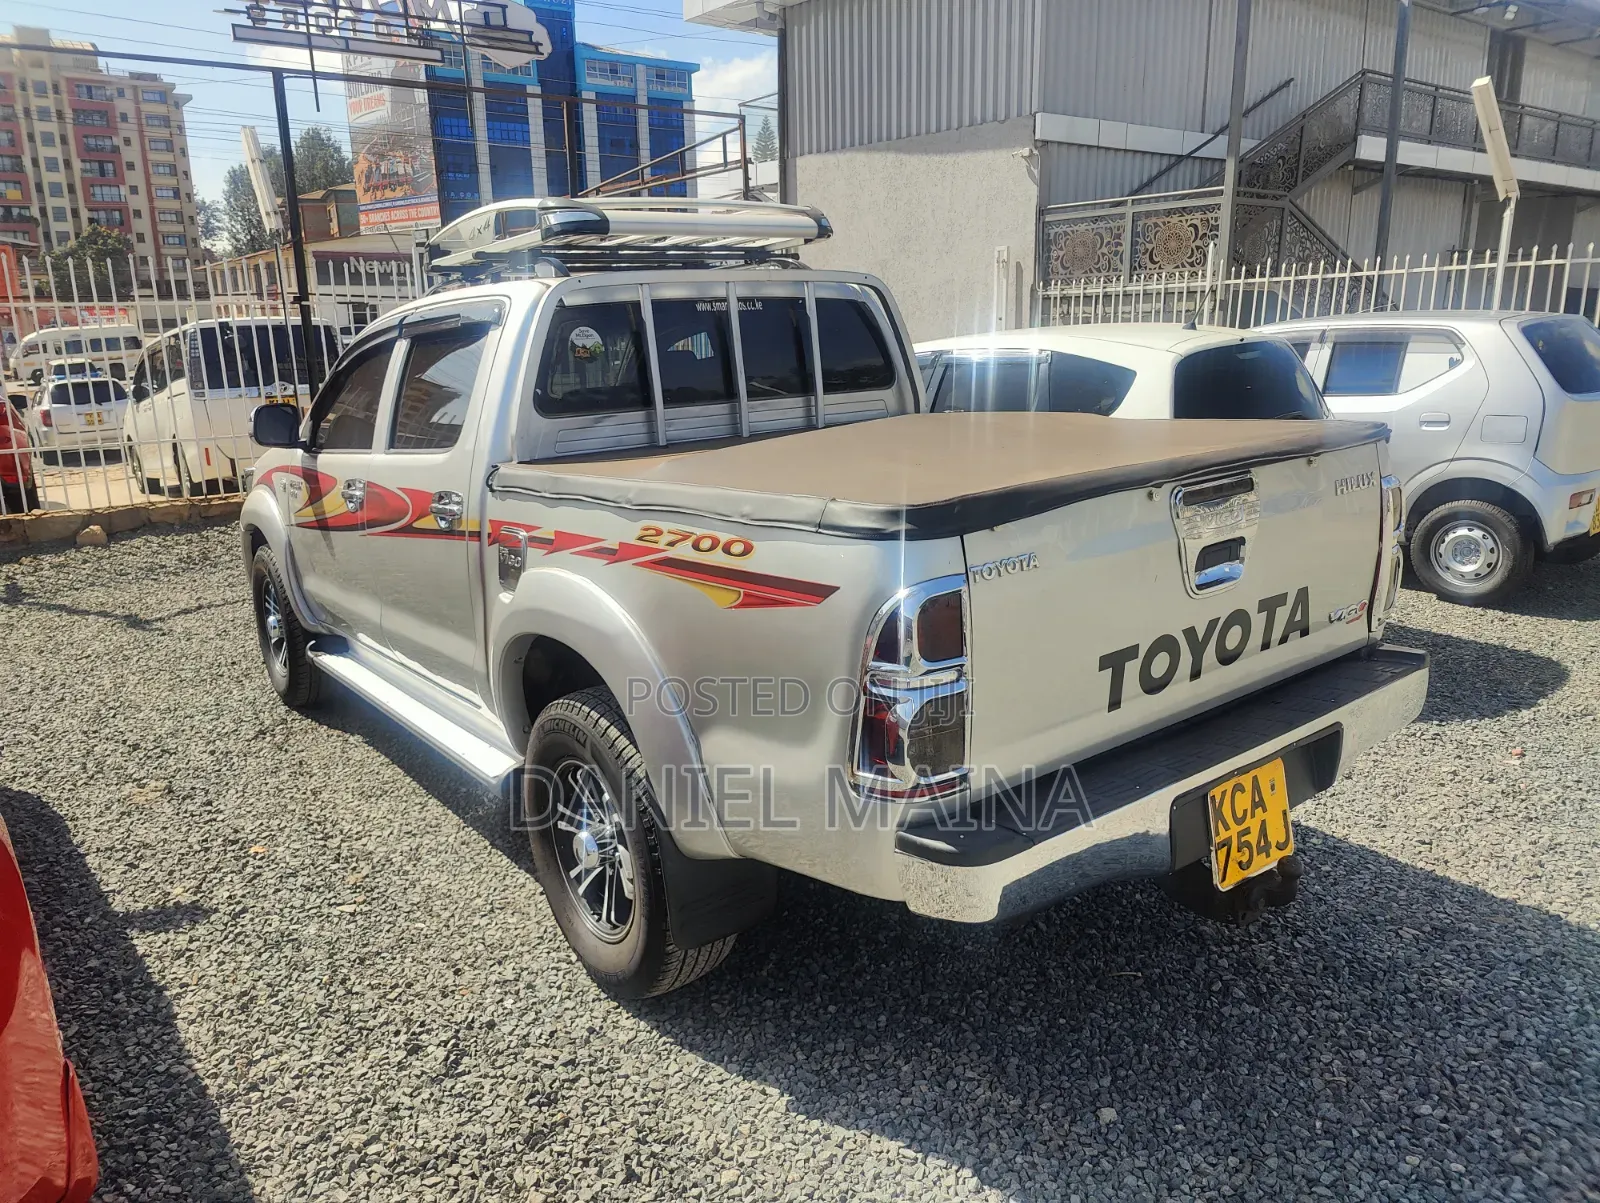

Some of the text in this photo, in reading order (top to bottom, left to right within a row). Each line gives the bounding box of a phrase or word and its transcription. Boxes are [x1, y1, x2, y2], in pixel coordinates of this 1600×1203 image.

[1334, 471, 1376, 496] HILUX
[635, 526, 755, 560] 2700
[969, 552, 1040, 584] TOYOTA
[1098, 586, 1310, 713] TOYOTA
[540, 718, 588, 749] MICHELIN
[1210, 775, 1268, 838] KCA
[1216, 809, 1290, 883] 754J
